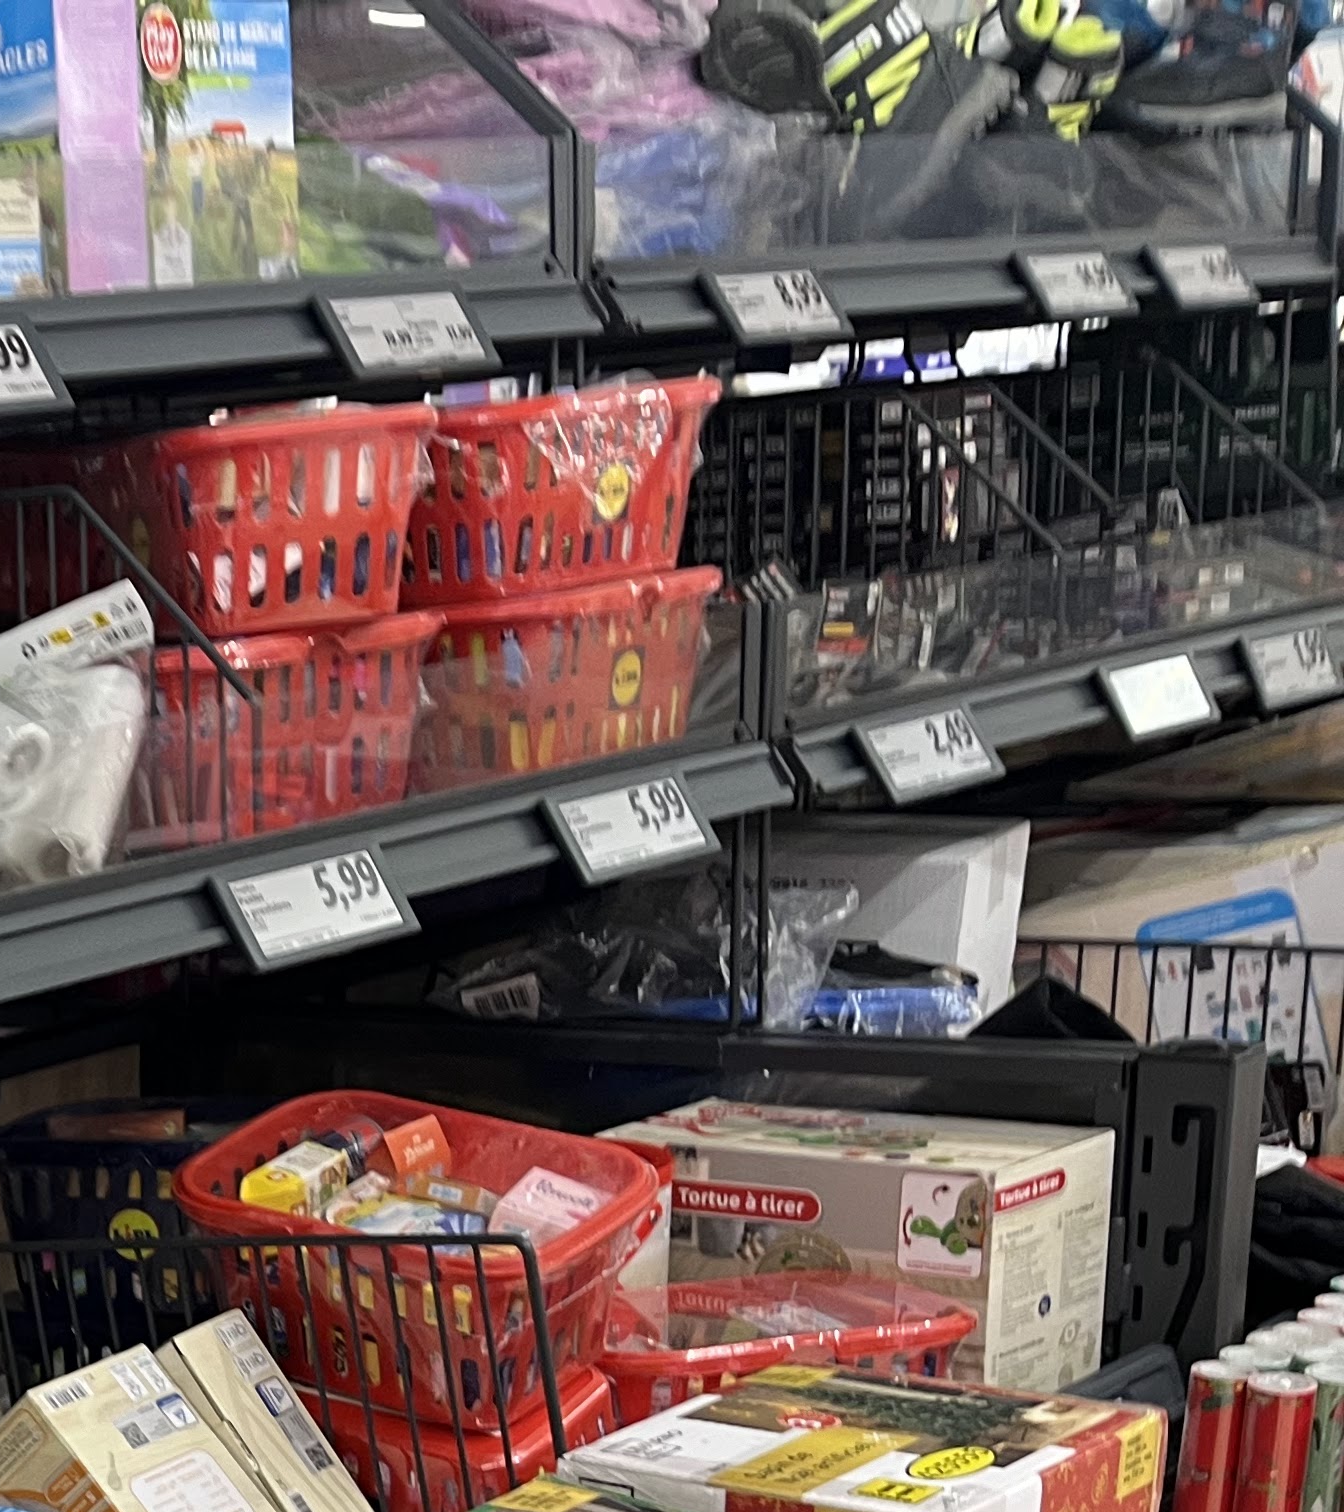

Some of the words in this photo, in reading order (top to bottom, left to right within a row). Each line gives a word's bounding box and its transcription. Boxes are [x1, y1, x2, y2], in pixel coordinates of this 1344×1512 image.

[924, 708, 978, 757] 2,49
[628, 777, 688, 831] 5,99
[313, 858, 382, 908] 5,99
[678, 1185, 740, 1213] Tortue
[745, 1189, 757, 1214] à
[760, 1191, 806, 1218] tirer
[999, 1184, 1031, 1210] Tortue
[1040, 1172, 1063, 1196] tirer
